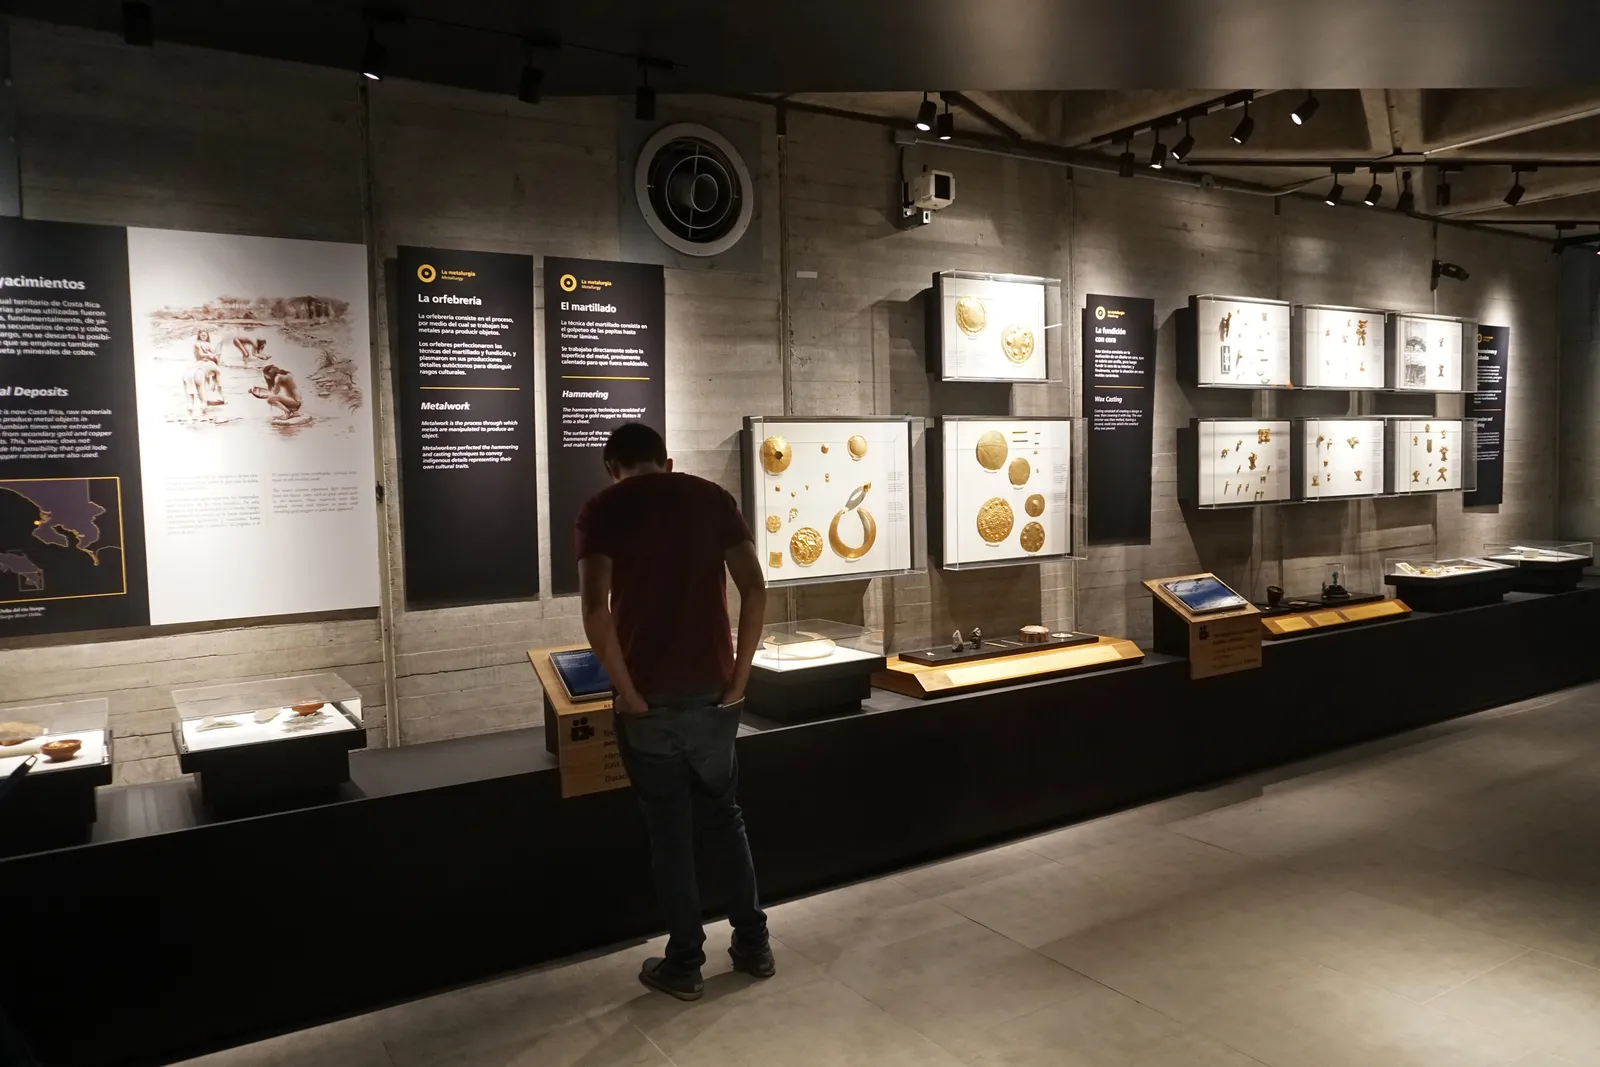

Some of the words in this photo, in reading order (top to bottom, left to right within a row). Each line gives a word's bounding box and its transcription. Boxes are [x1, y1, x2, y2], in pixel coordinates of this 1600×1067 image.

[418, 294, 430, 303] La
[432, 294, 482, 305] orfebrería
[560, 302, 569, 310] El
[572, 303, 616, 313] martillado
[1102, 327, 1126, 335] fundición
[14, 387, 69, 398] Deposits
[562, 390, 609, 400] Hammering
[420, 402, 470, 410] Metalwork
